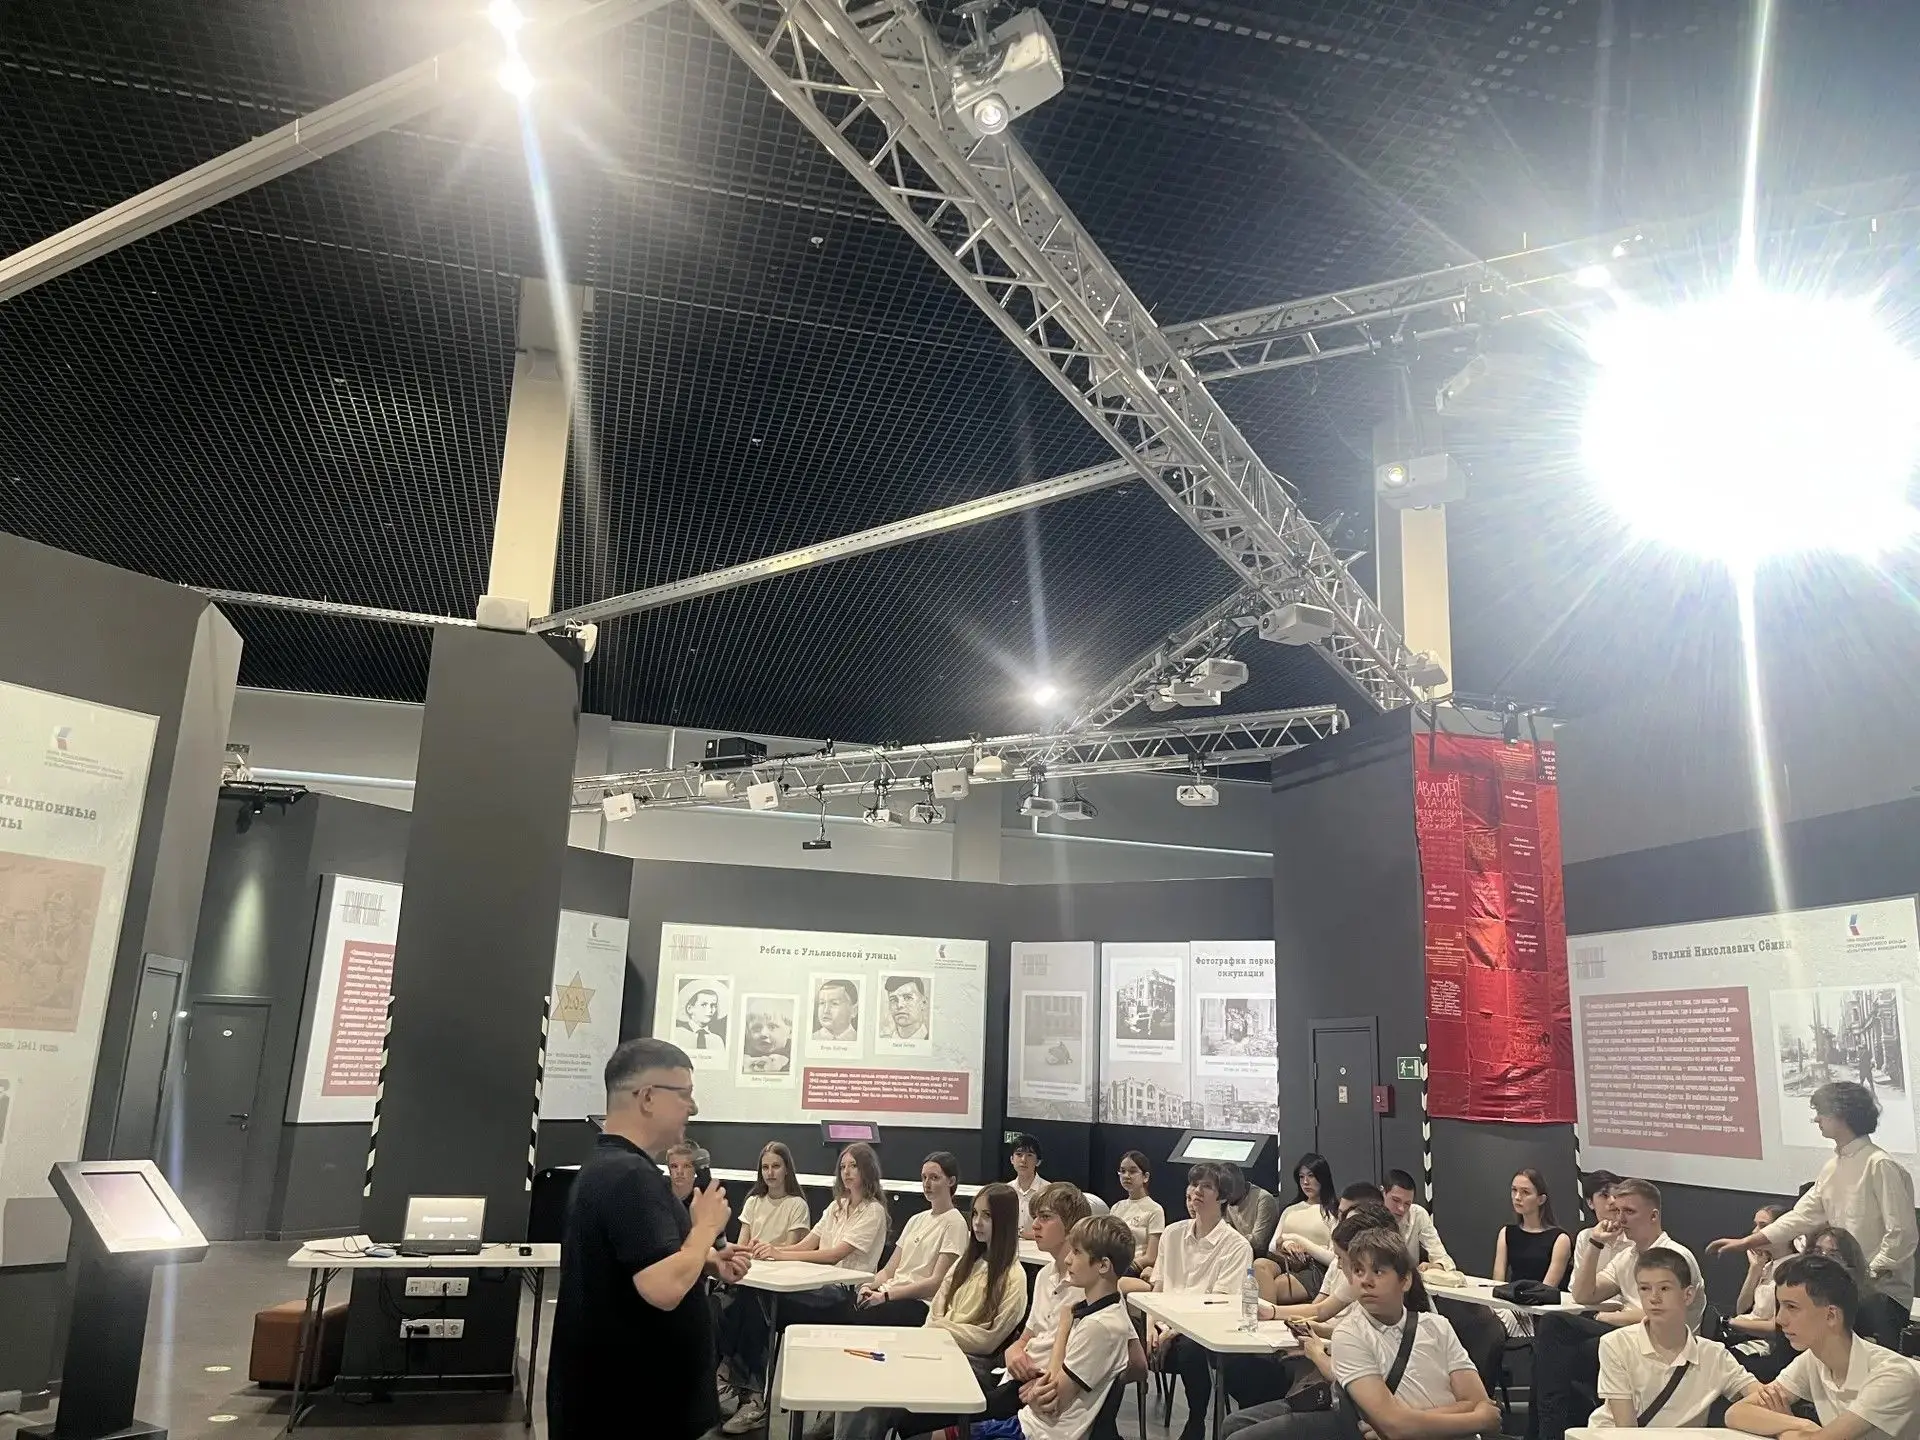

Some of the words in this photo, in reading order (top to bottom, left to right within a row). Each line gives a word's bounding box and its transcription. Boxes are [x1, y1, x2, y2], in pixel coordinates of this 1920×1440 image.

[1416, 781, 1457, 797] АВАГЯН
[759, 945, 791, 956] Ребята
[794, 948, 800, 956] с
[802, 947, 863, 960] Ульяновской
[865, 952, 897, 961] улицы
[1652, 947, 1692, 961] Виталий
[1694, 943, 1756, 957] Николаевич
[1195, 956, 1246, 967] Фотографии
[1248, 958, 1275, 967] перио
[1217, 970, 1264, 979] оккупации
